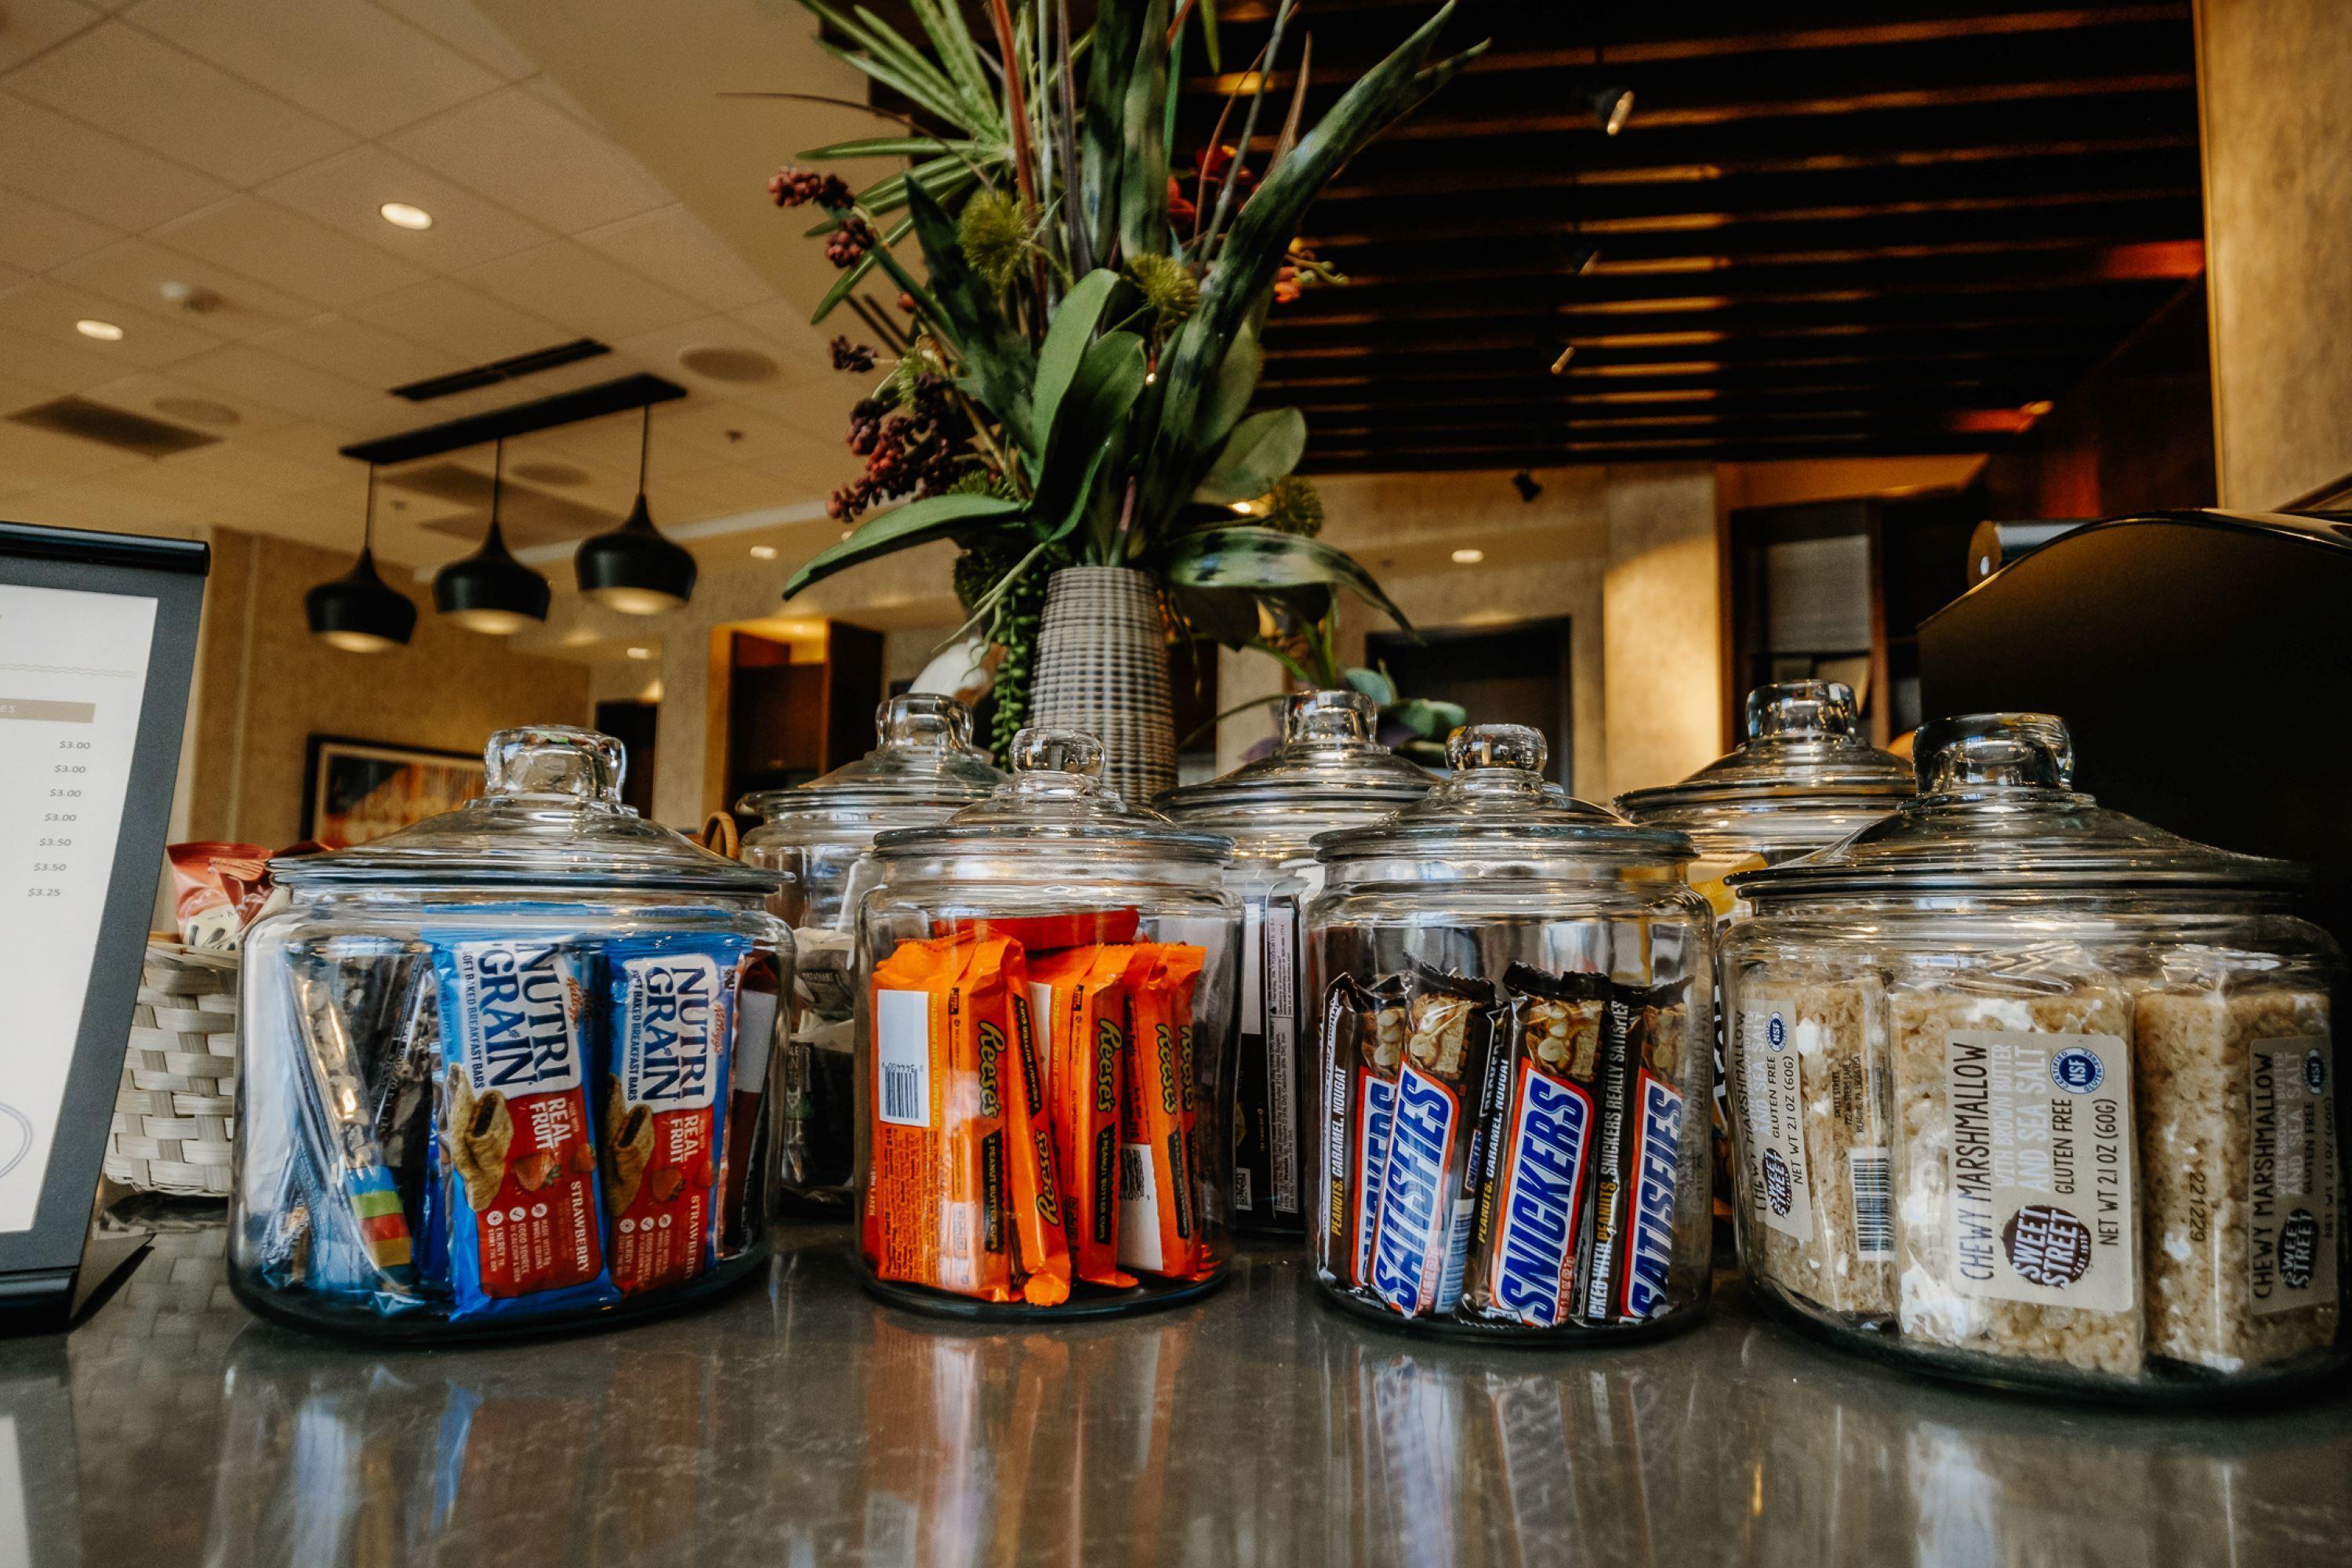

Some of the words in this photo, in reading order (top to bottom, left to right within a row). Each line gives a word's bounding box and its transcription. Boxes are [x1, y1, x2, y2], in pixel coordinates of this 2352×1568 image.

[54, 764, 86, 773] $3.00
[49, 789, 82, 797] $3.00
[45, 813, 76, 822] $3.00
[39, 838, 71, 847] $3.50
[34, 863, 67, 872] $3.50
[28, 888, 60, 897] $3.25
[465, 975, 476, 1004] BAKED
[633, 991, 643, 1021] BAKED
[468, 1007, 481, 1061] BREAKFAST
[477, 949, 538, 1087] GRAIN
[515, 944, 570, 1081] NUTRI
[641, 967, 681, 1101] GRAIN
[670, 967, 709, 1098] NUTRI
[711, 1004, 725, 1054] Kellogg's
[1019, 1000, 1028, 1024] CUPS
[1607, 1000, 1629, 1063] SATISFIES
[1752, 1011, 1766, 1052] SALT
[1772, 1022, 1780, 1043] NSF
[630, 1023, 641, 1074] BREAKFAST
[1024, 1025, 1033, 1062] BUTTER
[1098, 1019, 1122, 1112] Reese's
[473, 1064, 483, 1089] BARS
[627, 1076, 638, 1101] BARS
[932, 1070, 938, 1080] TO
[978, 1021, 1006, 1120] Reese's
[1053, 1062, 1058, 1073] TO
[1156, 1024, 1178, 1116] Reese's
[1603, 1065, 1625, 1109] REALLY
[1734, 1010, 1755, 1143] MARSHMALLOW
[1753, 1062, 1766, 1092] SEA
[1766, 1056, 1777, 1084] FREE
[1782, 1055, 1795, 1091] (60G)
[1991, 1044, 2012, 1091] BUTTER
[2014, 1044, 2047, 1094] SALT
[2050, 1050, 2070, 1089] CERTIFIED
[2068, 1059, 2087, 1083] NSF
[2082, 1049, 2104, 1092] GLUTEN-FREE
[2274, 1051, 2287, 1100] BUTTER
[2285, 1051, 2302, 1099] SALT
[2309, 1061, 2321, 1083] NSF
[1332, 1065, 1346, 1115] NOUGAT
[1785, 1095, 1795, 1112] OZ
[529, 1102, 554, 1149] FRUIT
[547, 1098, 572, 1148] REAL
[1754, 1098, 1772, 1134] AND
[1769, 1090, 1780, 1138] GLUTEN
[1788, 1116, 1797, 1131] 2.1
[1952, 1042, 1992, 1202] MARSHMALLOW
[1993, 1096, 2014, 1146] BROWN
[2016, 1103, 2049, 1141] SEA
[2051, 1098, 2073, 1132] FREE
[2092, 1098, 2118, 1139] (60G)
[2253, 1053, 2275, 1217] MARSHMALLOW
[2275, 1105, 2287, 1155] BROWN
[2286, 1109, 2303, 1147] SEA
[2303, 1101, 2314, 1134] FREE
[670, 1117, 684, 1163] FRUIT
[684, 1114, 699, 1162] REAL
[1331, 1117, 1345, 1178] CARAMEL.
[1466, 1131, 1483, 1189] SNICKERS
[1599, 1112, 1622, 1176] SNICKERS
[1788, 1134, 1799, 1154] WT
[2096, 1145, 2117, 1163] OZ
[2324, 1142, 2333, 1160] OZ
[1034, 1129, 1060, 1225] Reese's
[1477, 1181, 1494, 1243] PEANUTS.
[1486, 1112, 1503, 1178] CARAMEL.
[1764, 1148, 1777, 1208] SWEET
[1773, 1151, 1788, 1218] STREET
[1791, 1160, 1803, 1185] NET
[1994, 1149, 2015, 1188] WITH
[2018, 1149, 2050, 1192] AND
[2053, 1138, 2075, 1194] GLUTEN
[2096, 1169, 2118, 1185] 2.1
[2276, 1159, 2287, 1197] WITH
[2287, 1154, 2304, 1195] AND
[2304, 1140, 2314, 1195] GLUTEN
[1330, 1180, 1343, 1236] PEANUTS.
[1374, 1070, 1449, 1313] SATISFIES
[1498, 1082, 1584, 1327] SNICKERS
[1632, 1084, 1681, 1316] SATISFIES
[2097, 1189, 2118, 1212] WT
[2189, 1171, 2206, 1242] 221229
[2324, 1185, 2333, 1206] WT
[495, 1227, 505, 1257] ENERGY
[518, 1223, 528, 1243] GOOD
[571, 1181, 589, 1272] STRAWBERRY
[684, 1196, 700, 1280] STRAWBERRY
[989, 1225, 998, 1250] CUPS
[1958, 1207, 1994, 1280] CHEWY
[2012, 1204, 2049, 1278] SWEET
[2041, 1207, 2078, 1287] STREET
[2097, 1218, 2119, 1246] NET
[2280, 1209, 2299, 1284] SWEET
[2292, 1211, 2313, 1286] STREET
[520, 1245, 529, 1274] SOURCE
[1592, 1243, 1611, 1278] WITH
[2252, 1225, 2274, 1299] CHEWY
